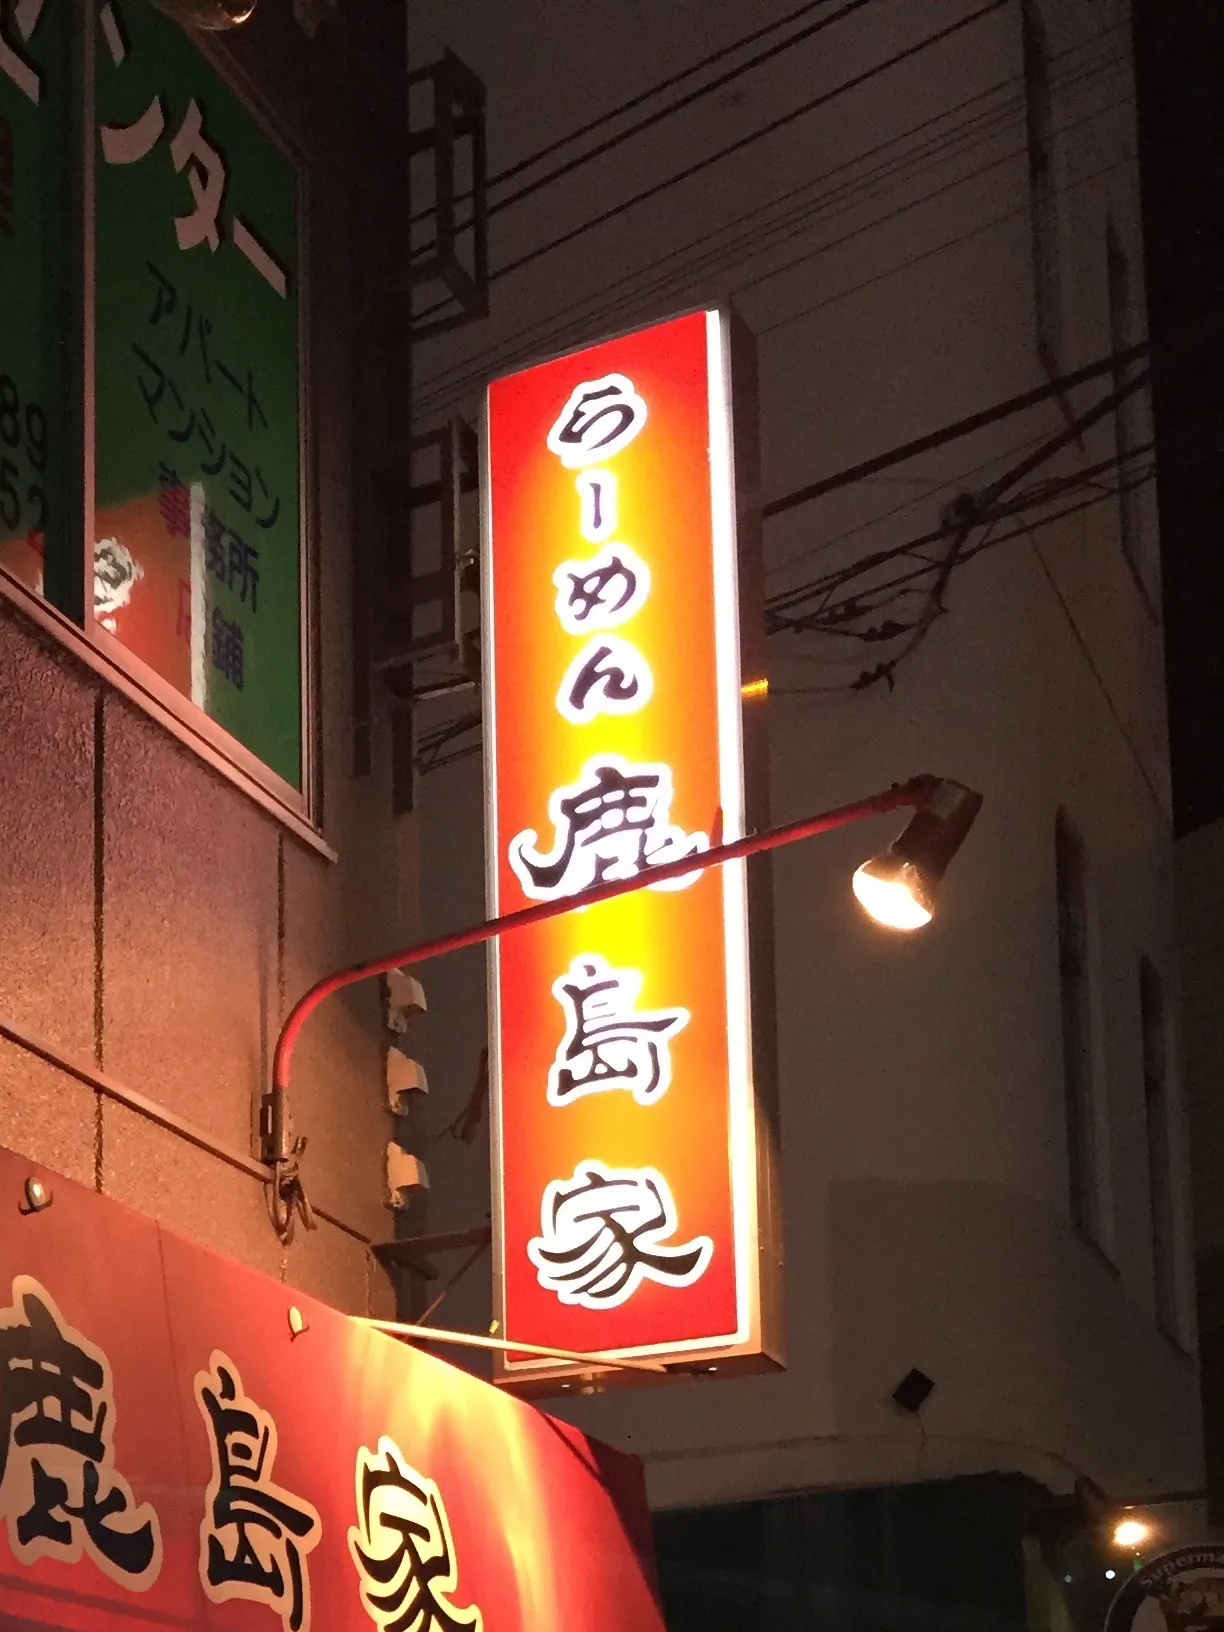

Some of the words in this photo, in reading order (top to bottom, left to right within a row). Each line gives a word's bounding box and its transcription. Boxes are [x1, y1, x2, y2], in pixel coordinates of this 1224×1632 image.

[147, 259, 268, 430] アパート
[132, 342, 279, 529] マンション
